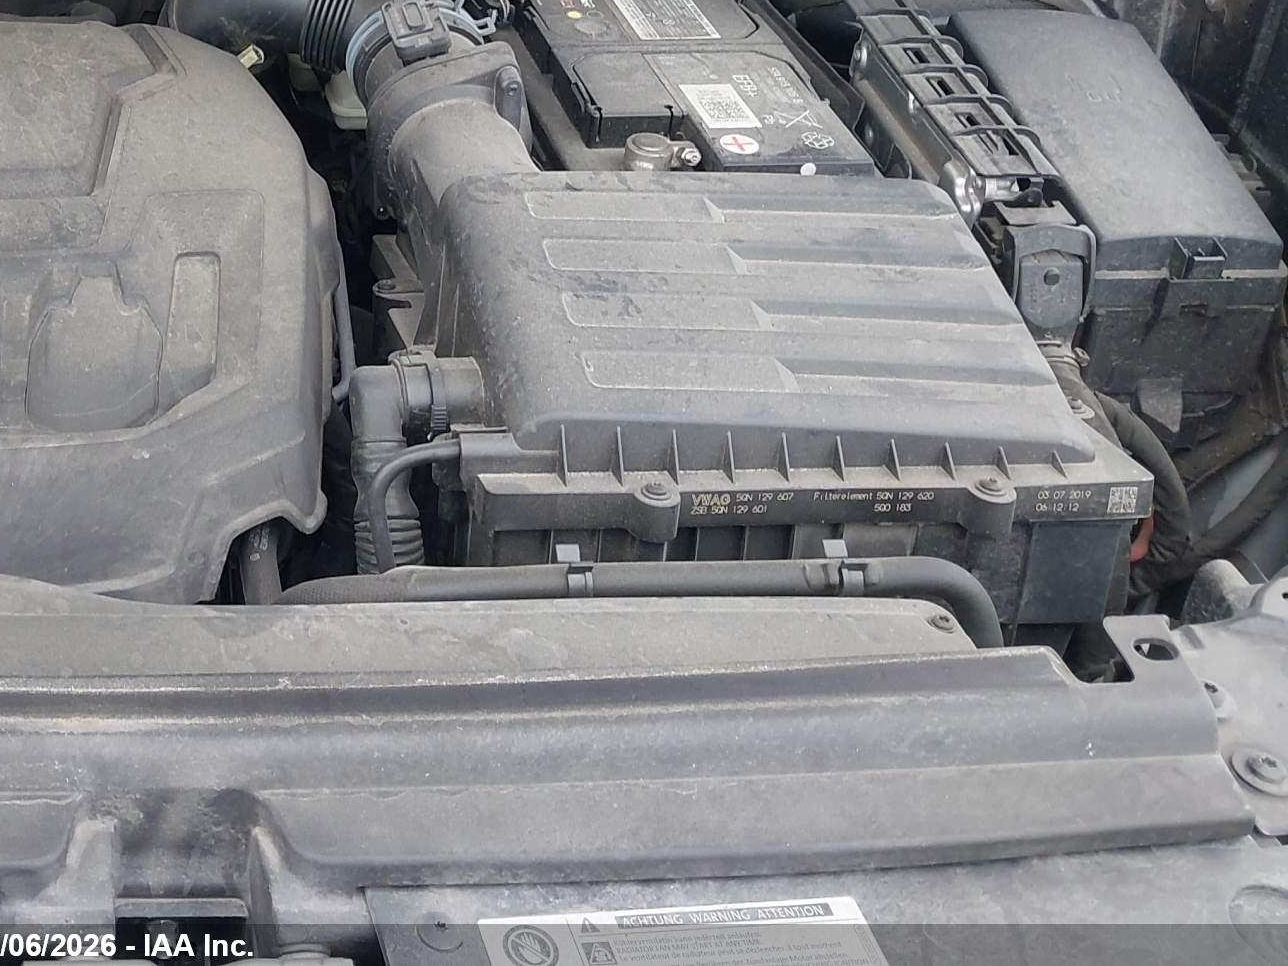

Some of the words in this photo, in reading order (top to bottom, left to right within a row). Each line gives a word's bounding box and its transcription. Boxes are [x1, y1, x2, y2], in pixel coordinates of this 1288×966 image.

[758, 493, 773, 502] 129
[777, 492, 794, 501] 607
[813, 491, 873, 501] Filterelement
[898, 491, 914, 500] 129
[917, 491, 934, 500] 620
[733, 505, 749, 514] 129
[752, 505, 768, 514] 601
[896, 502, 912, 512] 183
[622, 912, 684, 927] ACHTUNG
[689, 909, 751, 924] WARNING
[757, 905, 825, 919] ATTENTION
